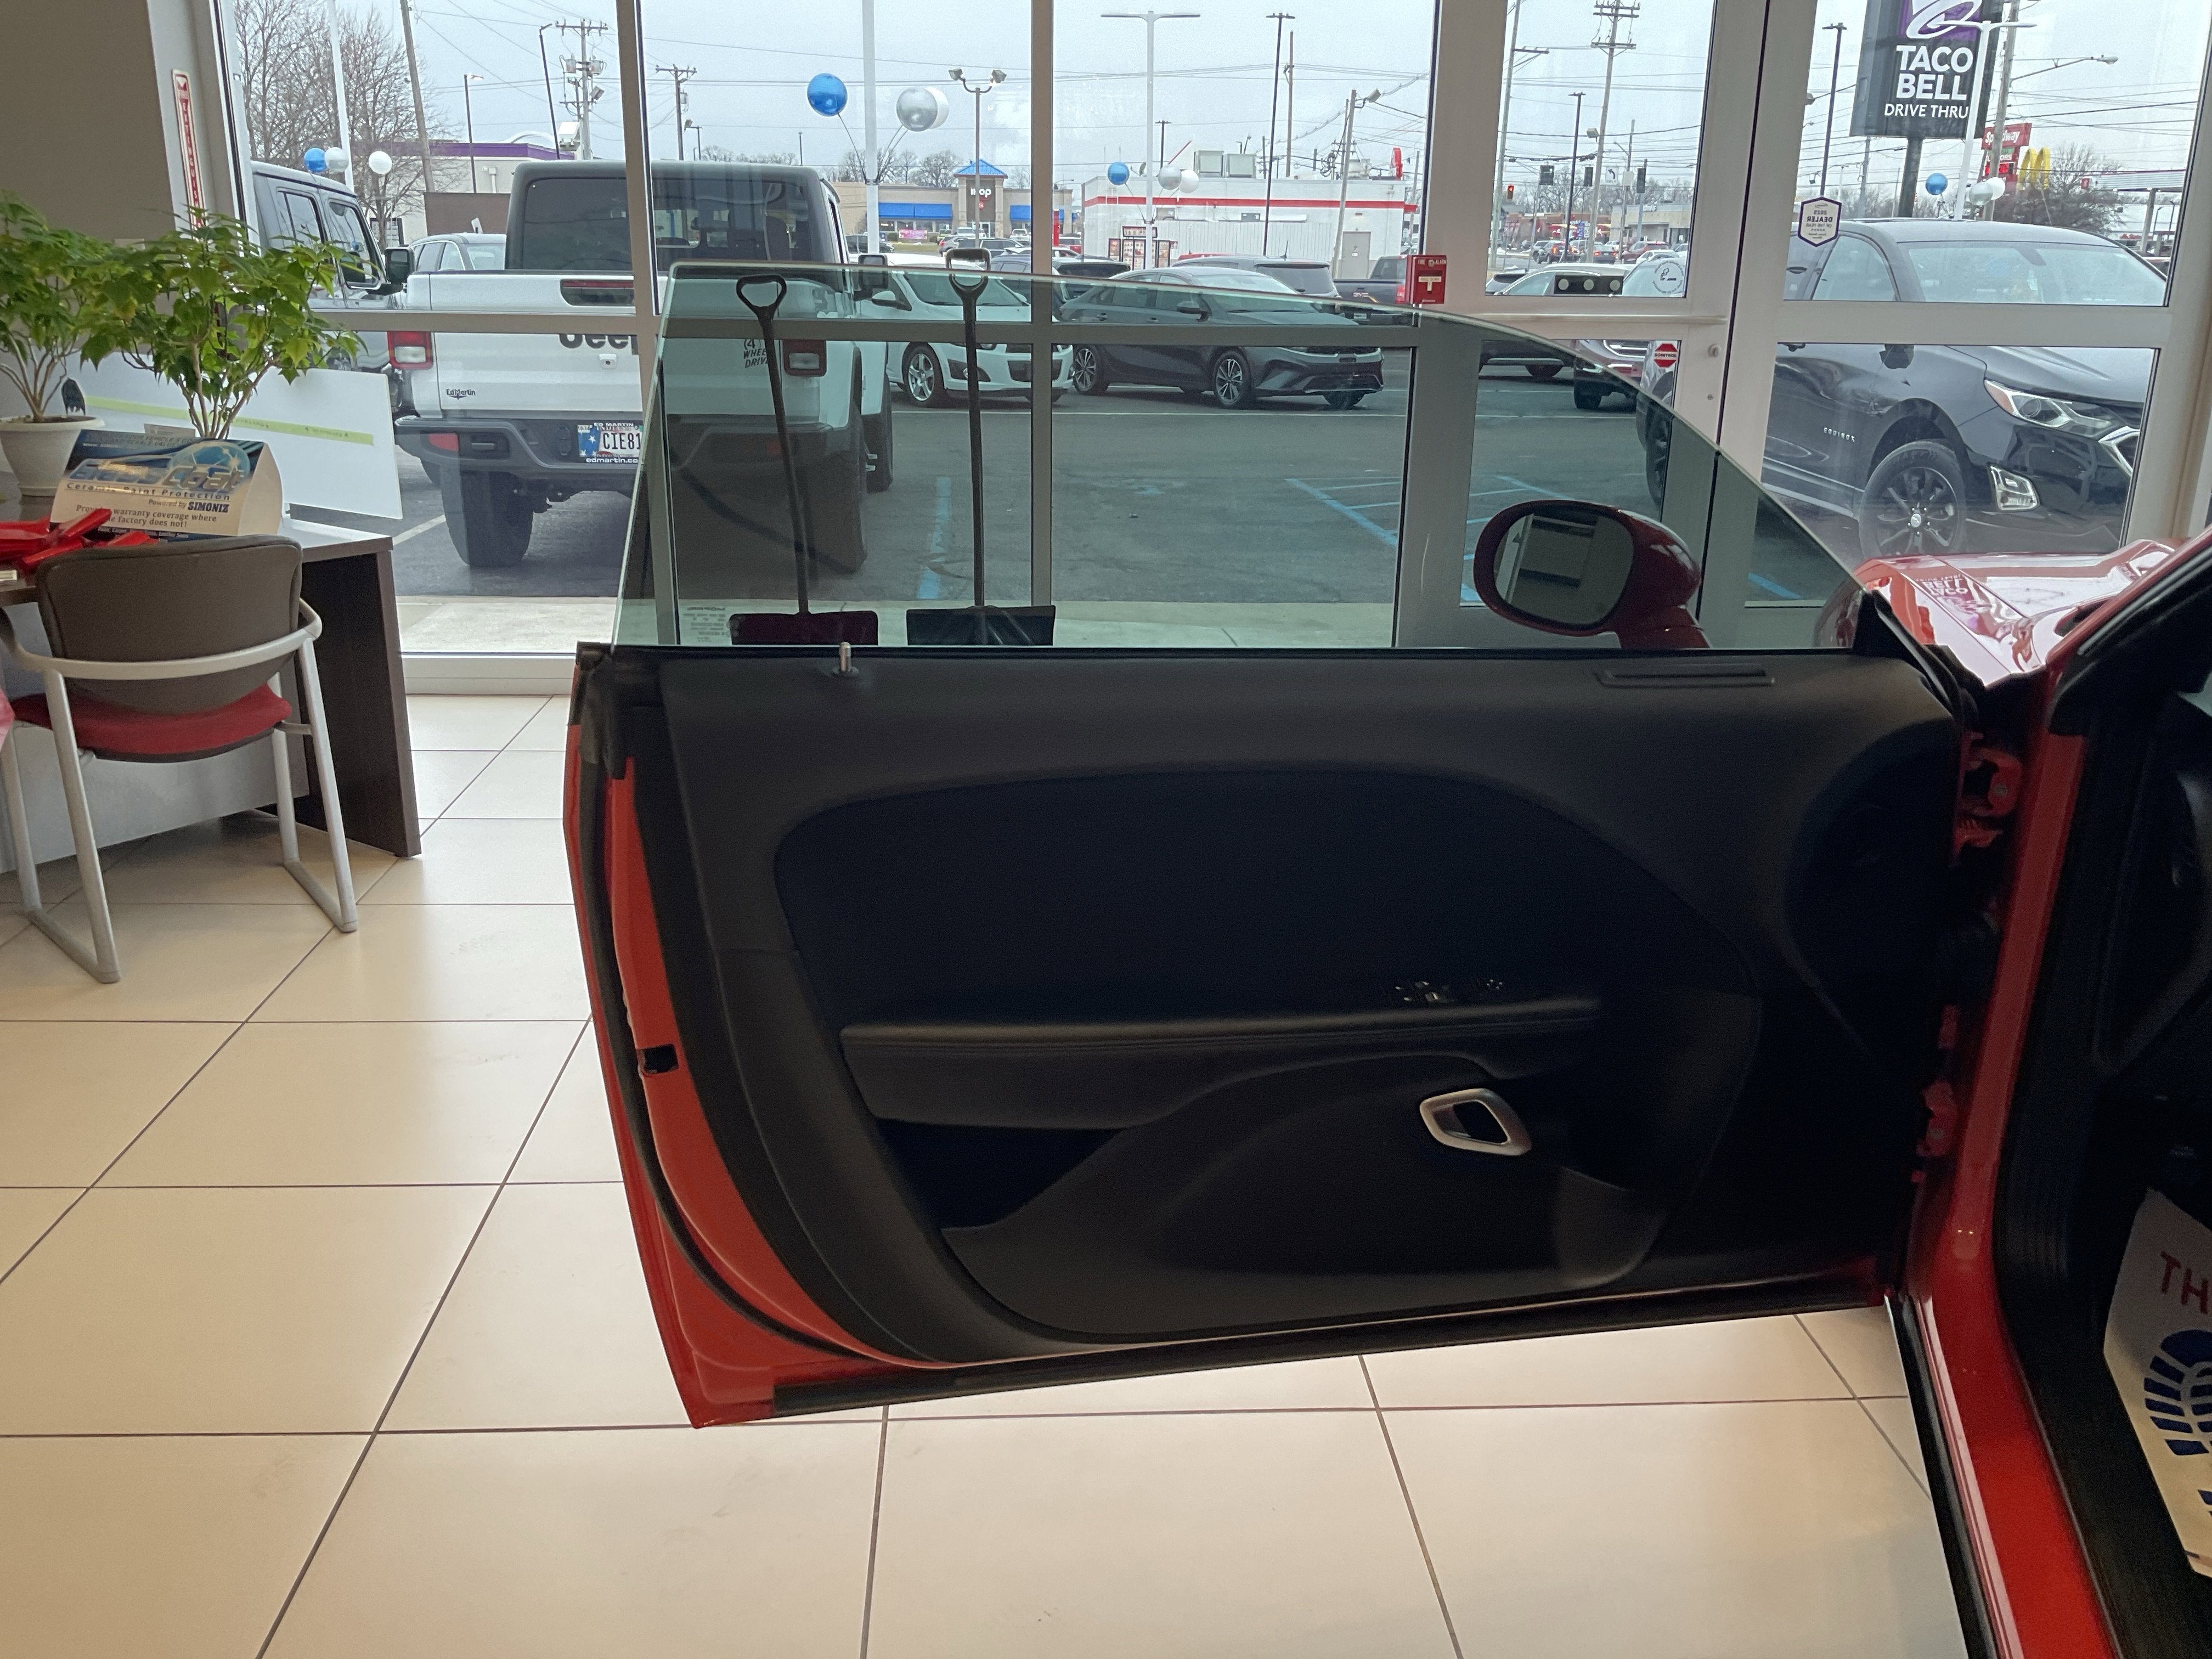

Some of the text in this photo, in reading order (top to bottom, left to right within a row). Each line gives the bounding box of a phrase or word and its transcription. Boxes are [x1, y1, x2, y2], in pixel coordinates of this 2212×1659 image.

[1896, 45, 1973, 73] TACO
[1896, 73, 1967, 100] BELL
[1884, 103, 1968, 119] DRIVE THRU
[1985, 130, 2021, 146] Spdway
[1823, 427, 1855, 442] EQUINOX
[161, 488, 231, 500] Protection
[188, 501, 229, 513] SIMONIZ
[114, 509, 150, 518] warranty
[153, 510, 190, 522] coverage
[191, 513, 217, 522] where
[118, 516, 148, 526] factory
[149, 518, 167, 526] does
[170, 520, 187, 528] not!
